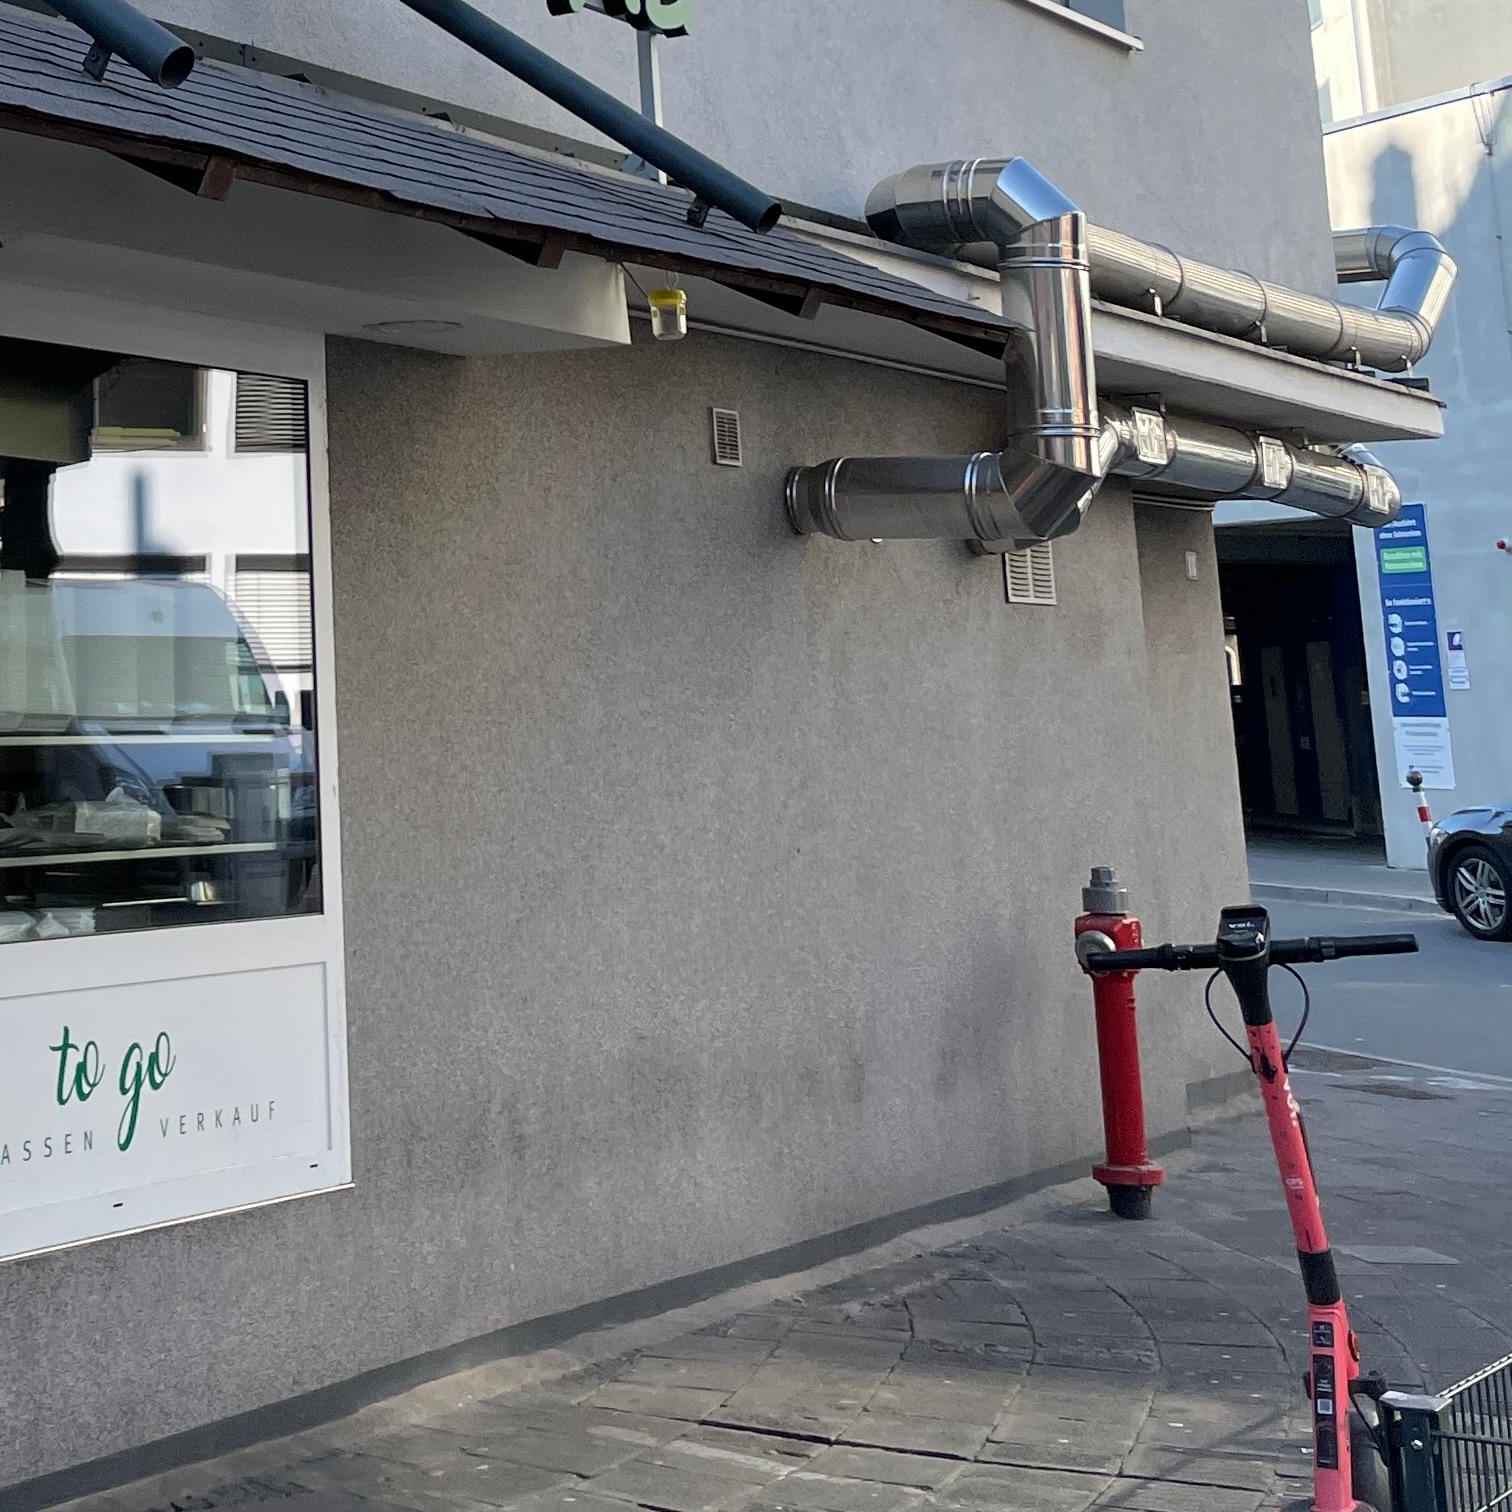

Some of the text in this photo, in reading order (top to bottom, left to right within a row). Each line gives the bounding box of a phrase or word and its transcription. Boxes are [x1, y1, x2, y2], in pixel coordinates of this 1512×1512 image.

[49, 1026, 177, 1152] to go
[159, 1100, 278, 1138] VERKAUF
